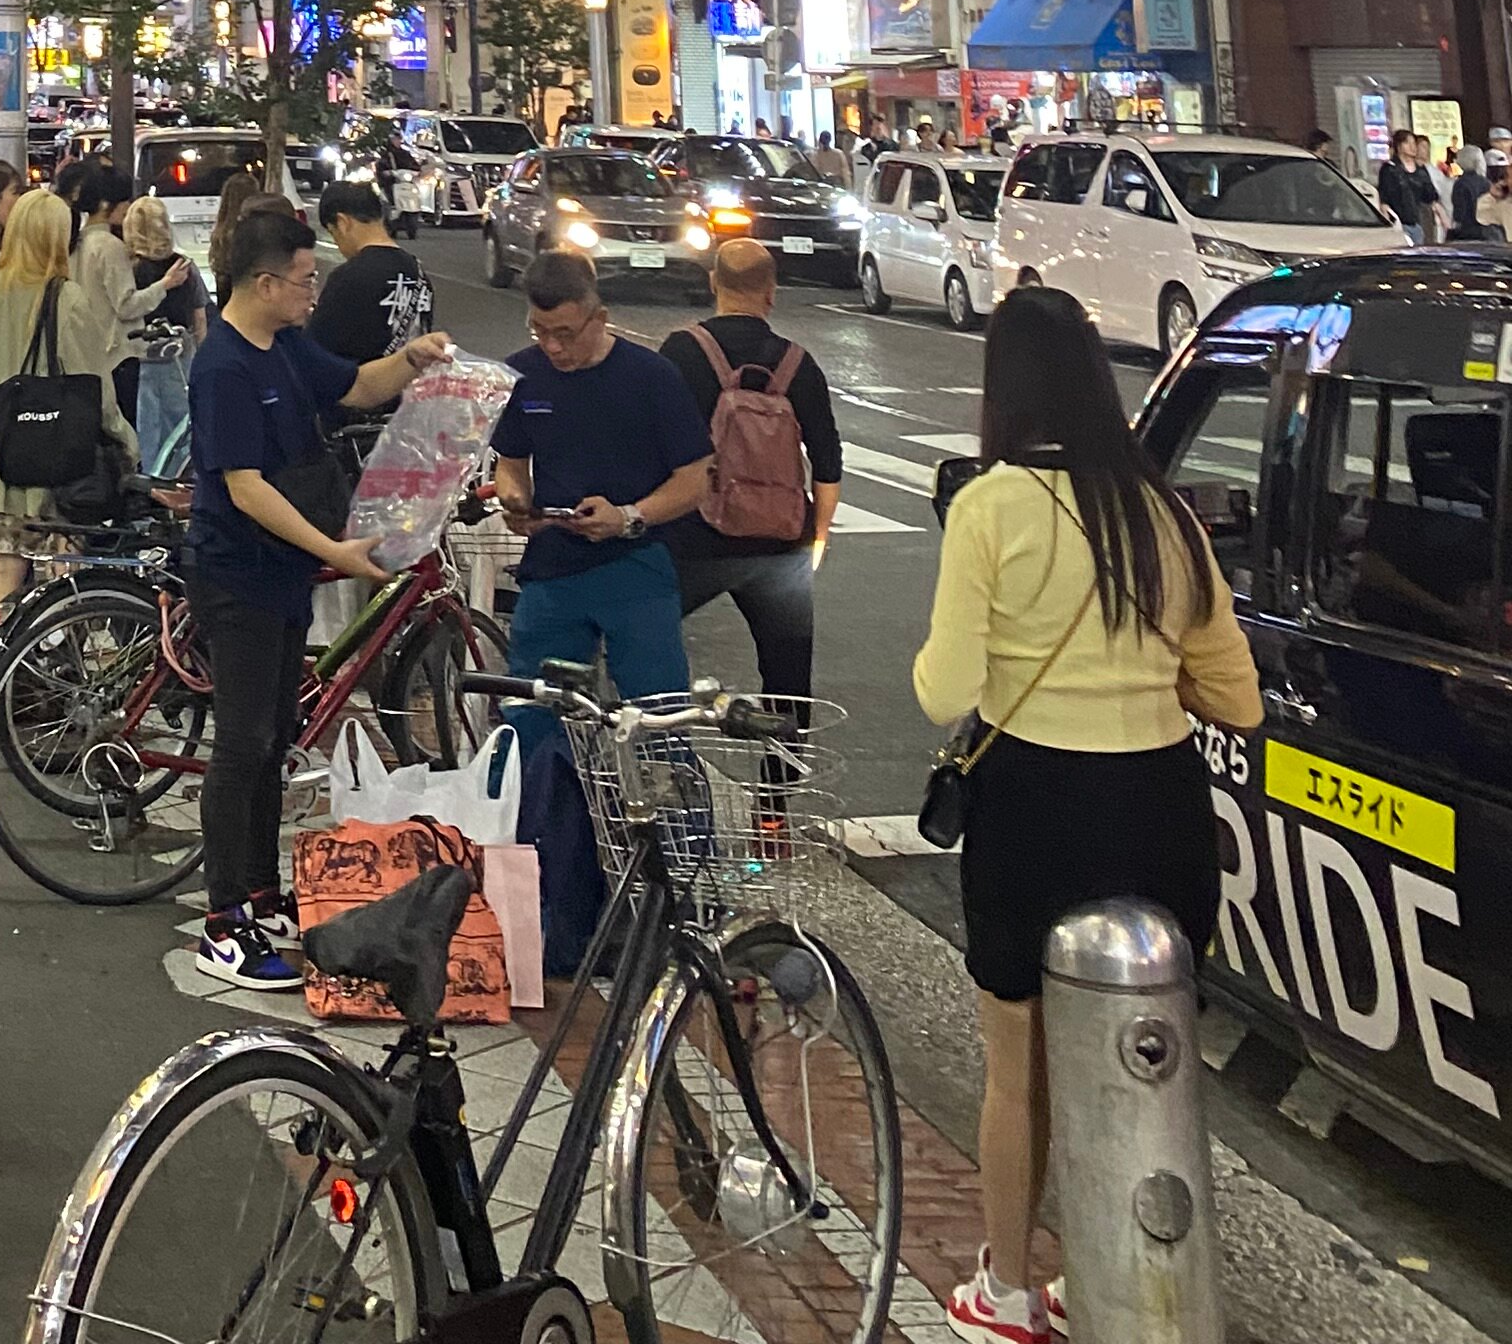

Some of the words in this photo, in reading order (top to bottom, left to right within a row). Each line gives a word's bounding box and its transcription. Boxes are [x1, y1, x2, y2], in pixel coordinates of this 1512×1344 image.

[1306, 767, 1406, 836] エスライド
[1210, 785, 1502, 1121] RIDE
